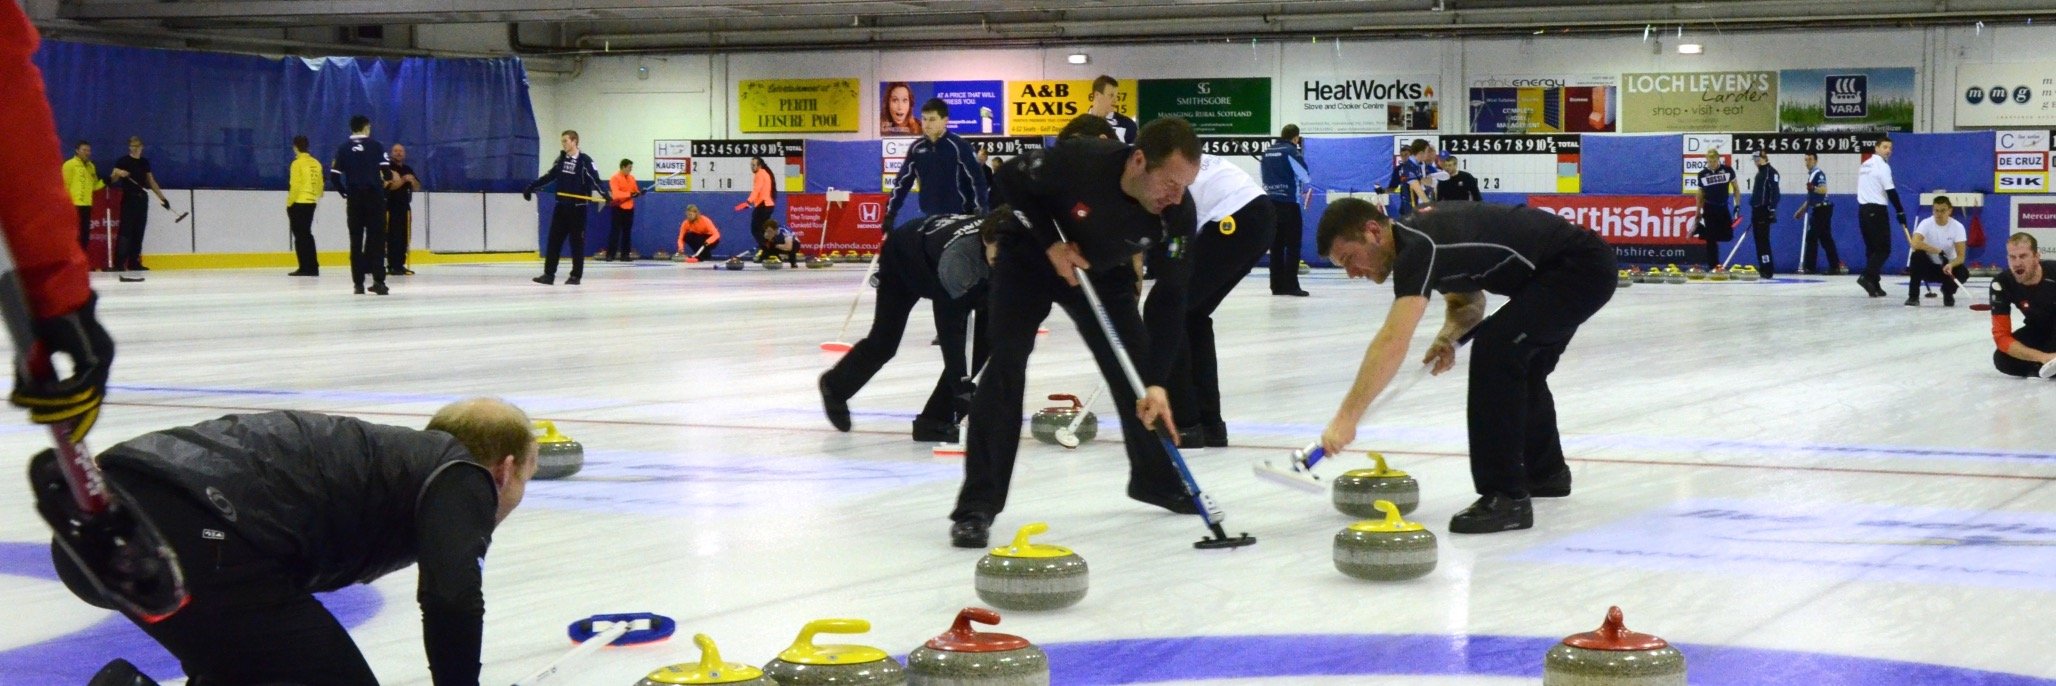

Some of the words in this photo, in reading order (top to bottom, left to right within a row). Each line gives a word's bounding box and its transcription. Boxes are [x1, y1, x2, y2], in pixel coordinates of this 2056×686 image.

[1628, 75, 1685, 93] LOCH
[1690, 73, 1770, 93] LEVEN'S
[1020, 84, 1069, 98] A&B
[1304, 79, 1423, 101] HeatWorks
[1702, 83, 1769, 103] Larder
[779, 98, 817, 111] PERTH
[1177, 96, 1232, 105] SMITHSGORE
[1012, 101, 1078, 115] TAXIS
[1652, 104, 1681, 117] shop
[1692, 104, 1713, 115] visit
[1723, 104, 1744, 115] eat
[1830, 105, 1862, 113] YARA
[758, 114, 804, 127] LEISURE
[812, 114, 839, 127] POOL
[977, 141, 984, 153] 7
[987, 141, 994, 153] 8
[996, 141, 1003, 153] 9
[1005, 141, 1014, 153] 10
[1202, 141, 1209, 152] 4
[1212, 141, 1219, 152] 5
[1222, 141, 1229, 152] 6
[1232, 141, 1239, 152] 7
[1241, 141, 1249, 152] 8
[1252, 141, 1259, 152] 9
[1261, 141, 1270, 152] 10
[1441, 139, 1447, 151] 1
[1451, 139, 1458, 151] 2
[1462, 139, 1469, 151] 3
[1472, 139, 1480, 151] 4
[1483, 139, 1490, 151] 5
[1494, 139, 1501, 151] 6
[1505, 139, 1512, 151] 7
[1515, 139, 1523, 151] 8
[1526, 139, 1533, 151] 9
[1536, 139, 1546, 151] 10
[1688, 138, 1700, 151] D
[1735, 138, 1741, 150] 1
[1746, 138, 1753, 150] 2
[1758, 138, 1765, 150] 3
[1769, 138, 1776, 150] 4
[1780, 138, 1788, 150] 5
[1792, 138, 1800, 150] 6
[1804, 138, 1811, 150] 7
[1816, 138, 1823, 150] 8
[1828, 138, 1835, 150] 9
[1839, 138, 1849, 150] 10
[2001, 133, 2014, 149] C
[658, 144, 667, 155] H
[692, 144, 698, 155] 1
[700, 144, 707, 155] 2
[709, 144, 715, 155] 3
[717, 144, 724, 155] 4
[726, 144, 733, 155] 5
[734, 144, 741, 155] 6
[743, 144, 750, 155] 7
[752, 144, 758, 155] 8
[760, 144, 767, 155] 9
[768, 144, 776, 155] 10
[886, 142, 897, 155] G
[692, 161, 698, 172] 2
[709, 161, 715, 172] 2
[1463, 159, 1467, 169] 1
[1736, 159, 1740, 170] 1
[2000, 157, 2012, 165] DE
[2015, 157, 2042, 165] CRUZ
[1484, 178, 1489, 189] 2
[1494, 178, 1499, 189] 3
[2000, 177, 2041, 186] SIK
[1612, 247, 1685, 257] hshire.com
